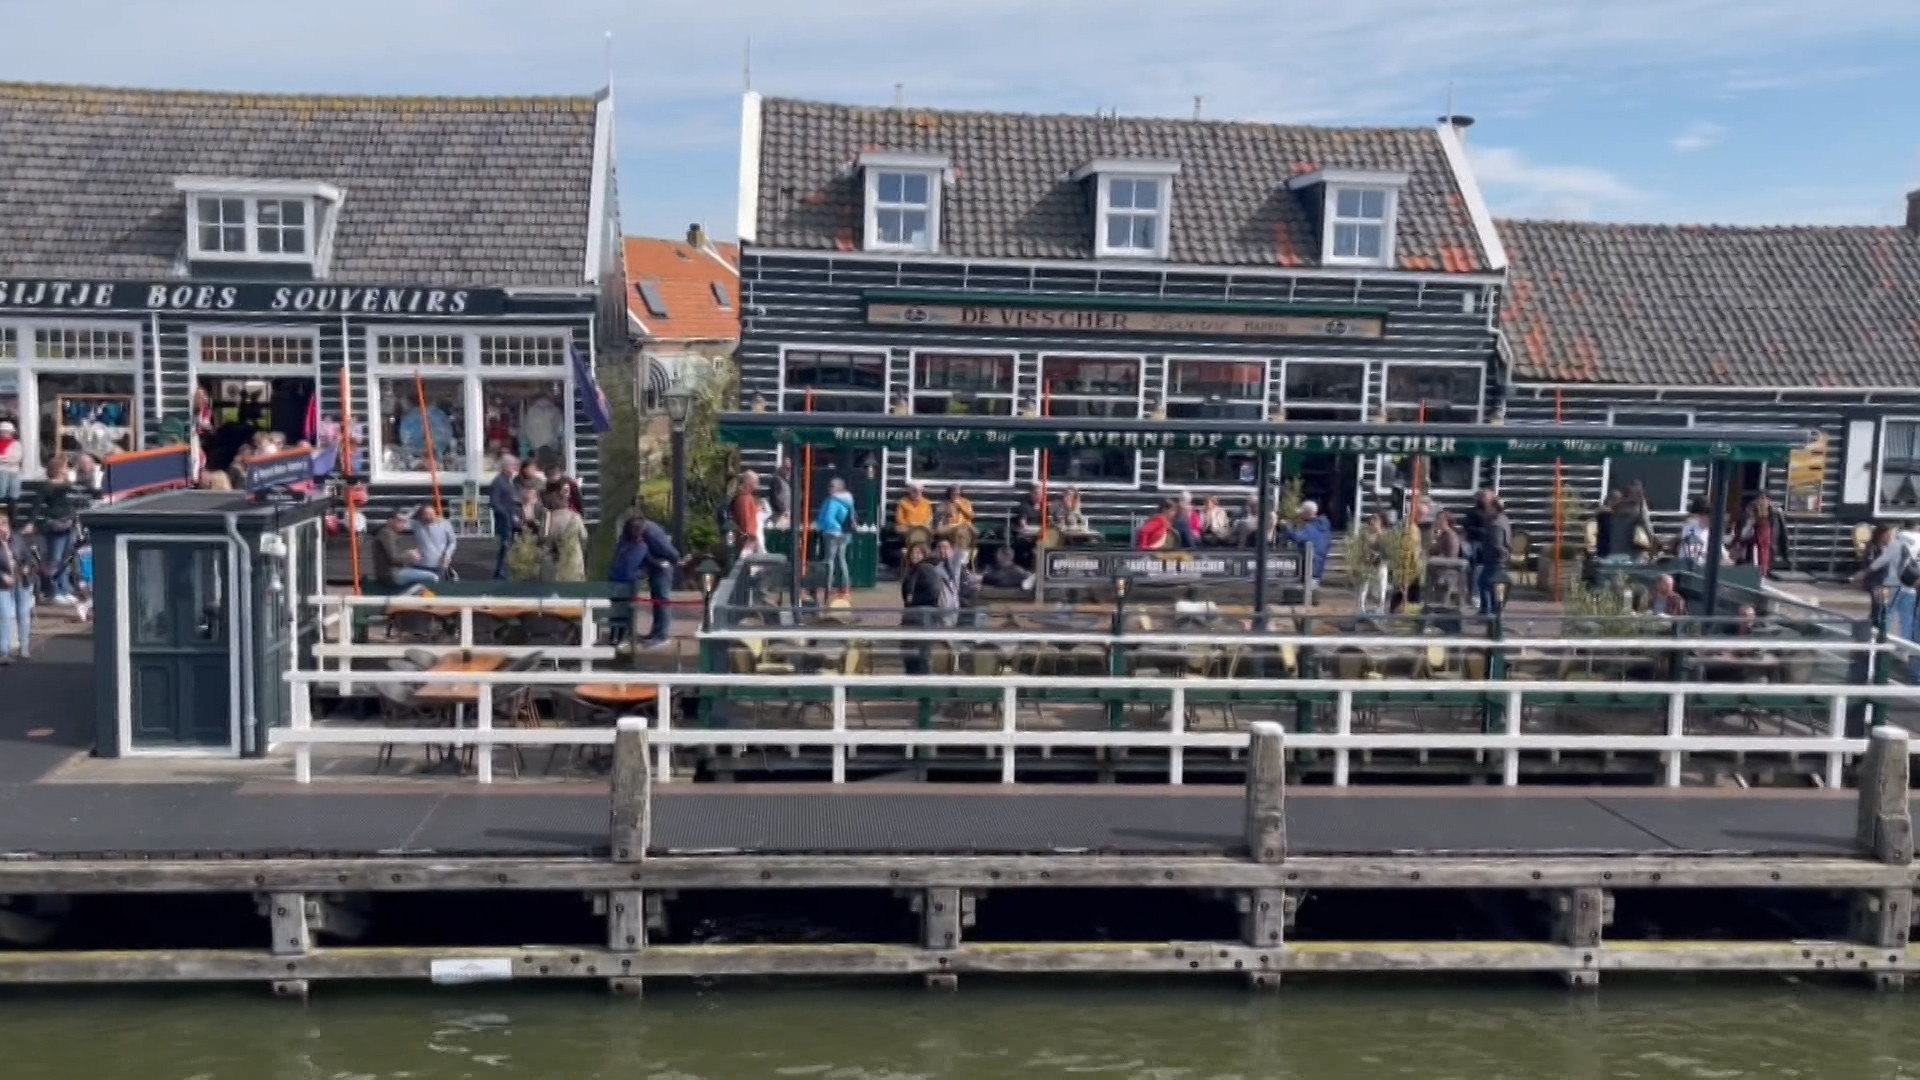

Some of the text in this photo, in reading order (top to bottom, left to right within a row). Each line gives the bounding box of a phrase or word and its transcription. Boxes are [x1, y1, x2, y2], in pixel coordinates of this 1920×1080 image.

[147, 284, 237, 308] BOES
[271, 286, 468, 312] SOUVENIRS
[961, 306, 993, 324] DE
[1000, 308, 1128, 330] VISSCHER
[833, 426, 920, 441] Restaurant
[985, 429, 1015, 442] Bar
[1056, 430, 1175, 448] TAVERNE
[1235, 433, 1309, 450] OUDE
[1321, 434, 1457, 453] VISSCHER
